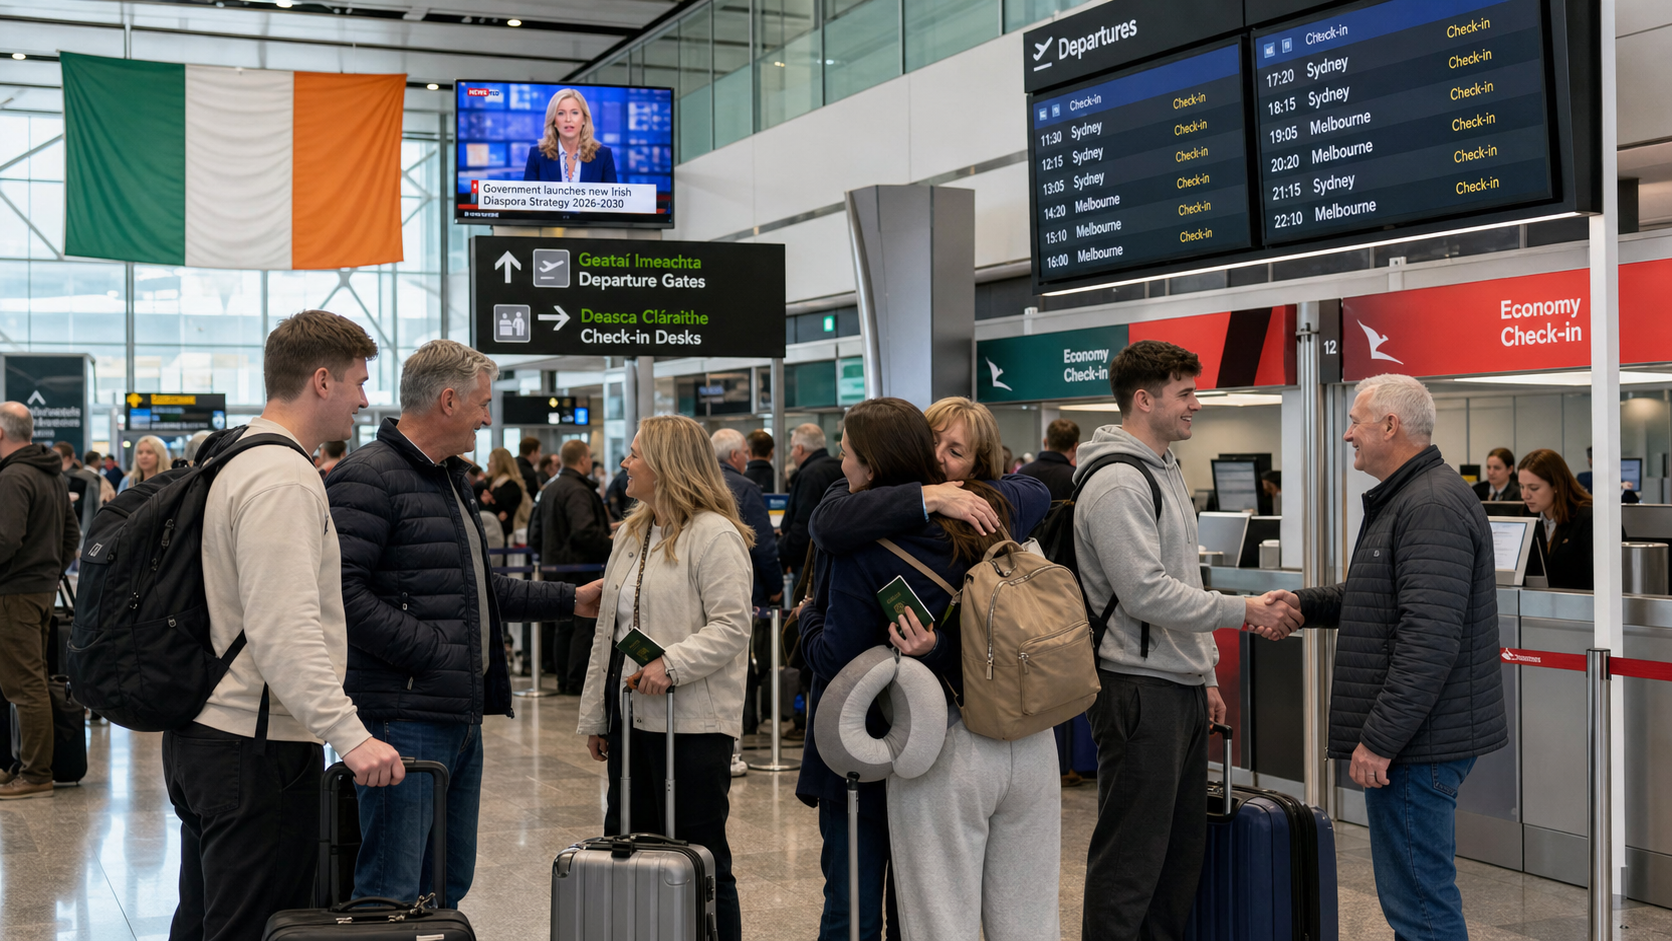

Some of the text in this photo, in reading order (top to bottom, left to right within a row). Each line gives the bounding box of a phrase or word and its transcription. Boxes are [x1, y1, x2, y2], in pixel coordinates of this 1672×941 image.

[1058, 19, 1138, 60] Departures
[1266, 17, 1490, 88] 17:20 Sydney Check-in
[1268, 48, 1492, 116] 18:15 Sydney Check-in
[1040, 92, 1206, 147] 11:30 Sydney Check-in
[1069, 94, 1102, 112] Check-in
[1269, 80, 1494, 144] 19:05 Melbourne Check-in
[1042, 119, 1208, 171] 12:15 Sydney Check-in
[1271, 112, 1496, 173] 20:20 Melbourne Check-in
[483, 184, 632, 197] Government launches new Irish
[1043, 146, 1209, 196] 13:05 Sydney Check-in
[1272, 144, 1498, 201] 21:15 Sydney Check-in
[483, 196, 624, 209] Diaspora Strategy 2026-2030
[1044, 173, 1210, 220] 14:20 Melbourne Check-in
[1274, 176, 1500, 229] 22:10 Melbourne Check-in
[1045, 200, 1212, 244] 15:10 Melbourne Check-in
[578, 252, 702, 270] Geataí Imeachta
[1046, 227, 1213, 268] 16:00 Melbourne Check-in
[578, 271, 706, 291] Departure Gates
[581, 308, 709, 325] Deasca Cláraithe
[1500, 297, 1582, 320] Economy
[580, 328, 702, 345] Check-in Desks
[1323, 339, 1337, 355] 12
[1500, 321, 1582, 347] Check-in
[1063, 348, 1110, 364] Economy
[1063, 365, 1109, 382] Check-in
